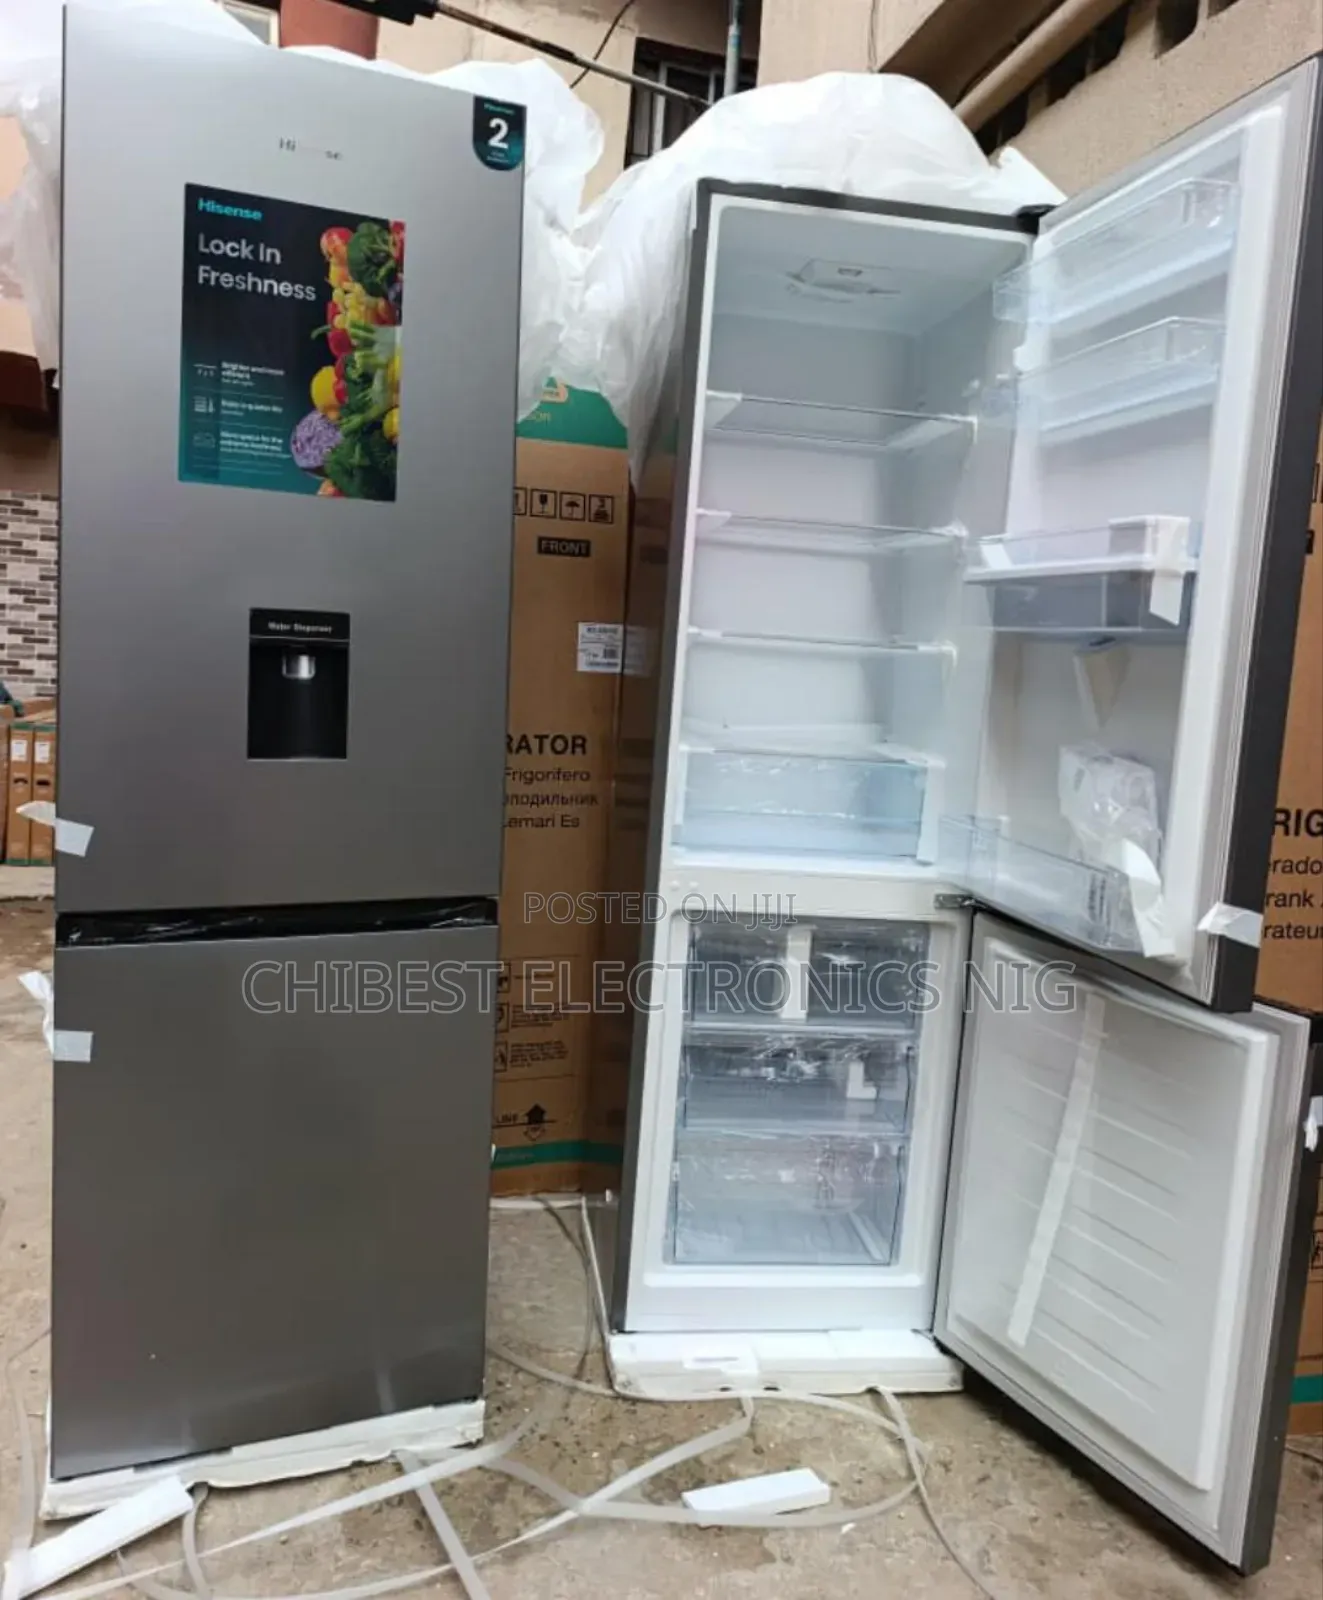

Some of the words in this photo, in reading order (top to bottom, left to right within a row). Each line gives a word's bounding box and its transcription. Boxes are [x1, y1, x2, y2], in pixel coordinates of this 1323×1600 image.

[488, 117, 509, 150] 2
[198, 198, 263, 220] Hisense
[199, 232, 254, 260] Lock
[259, 242, 282, 265] In
[198, 265, 317, 301] Freshness
[541, 539, 588, 556] FRONT
[560, 814, 580, 829] Es
[1268, 856, 1323, 876] rado
[1265, 888, 1315, 909] rank
